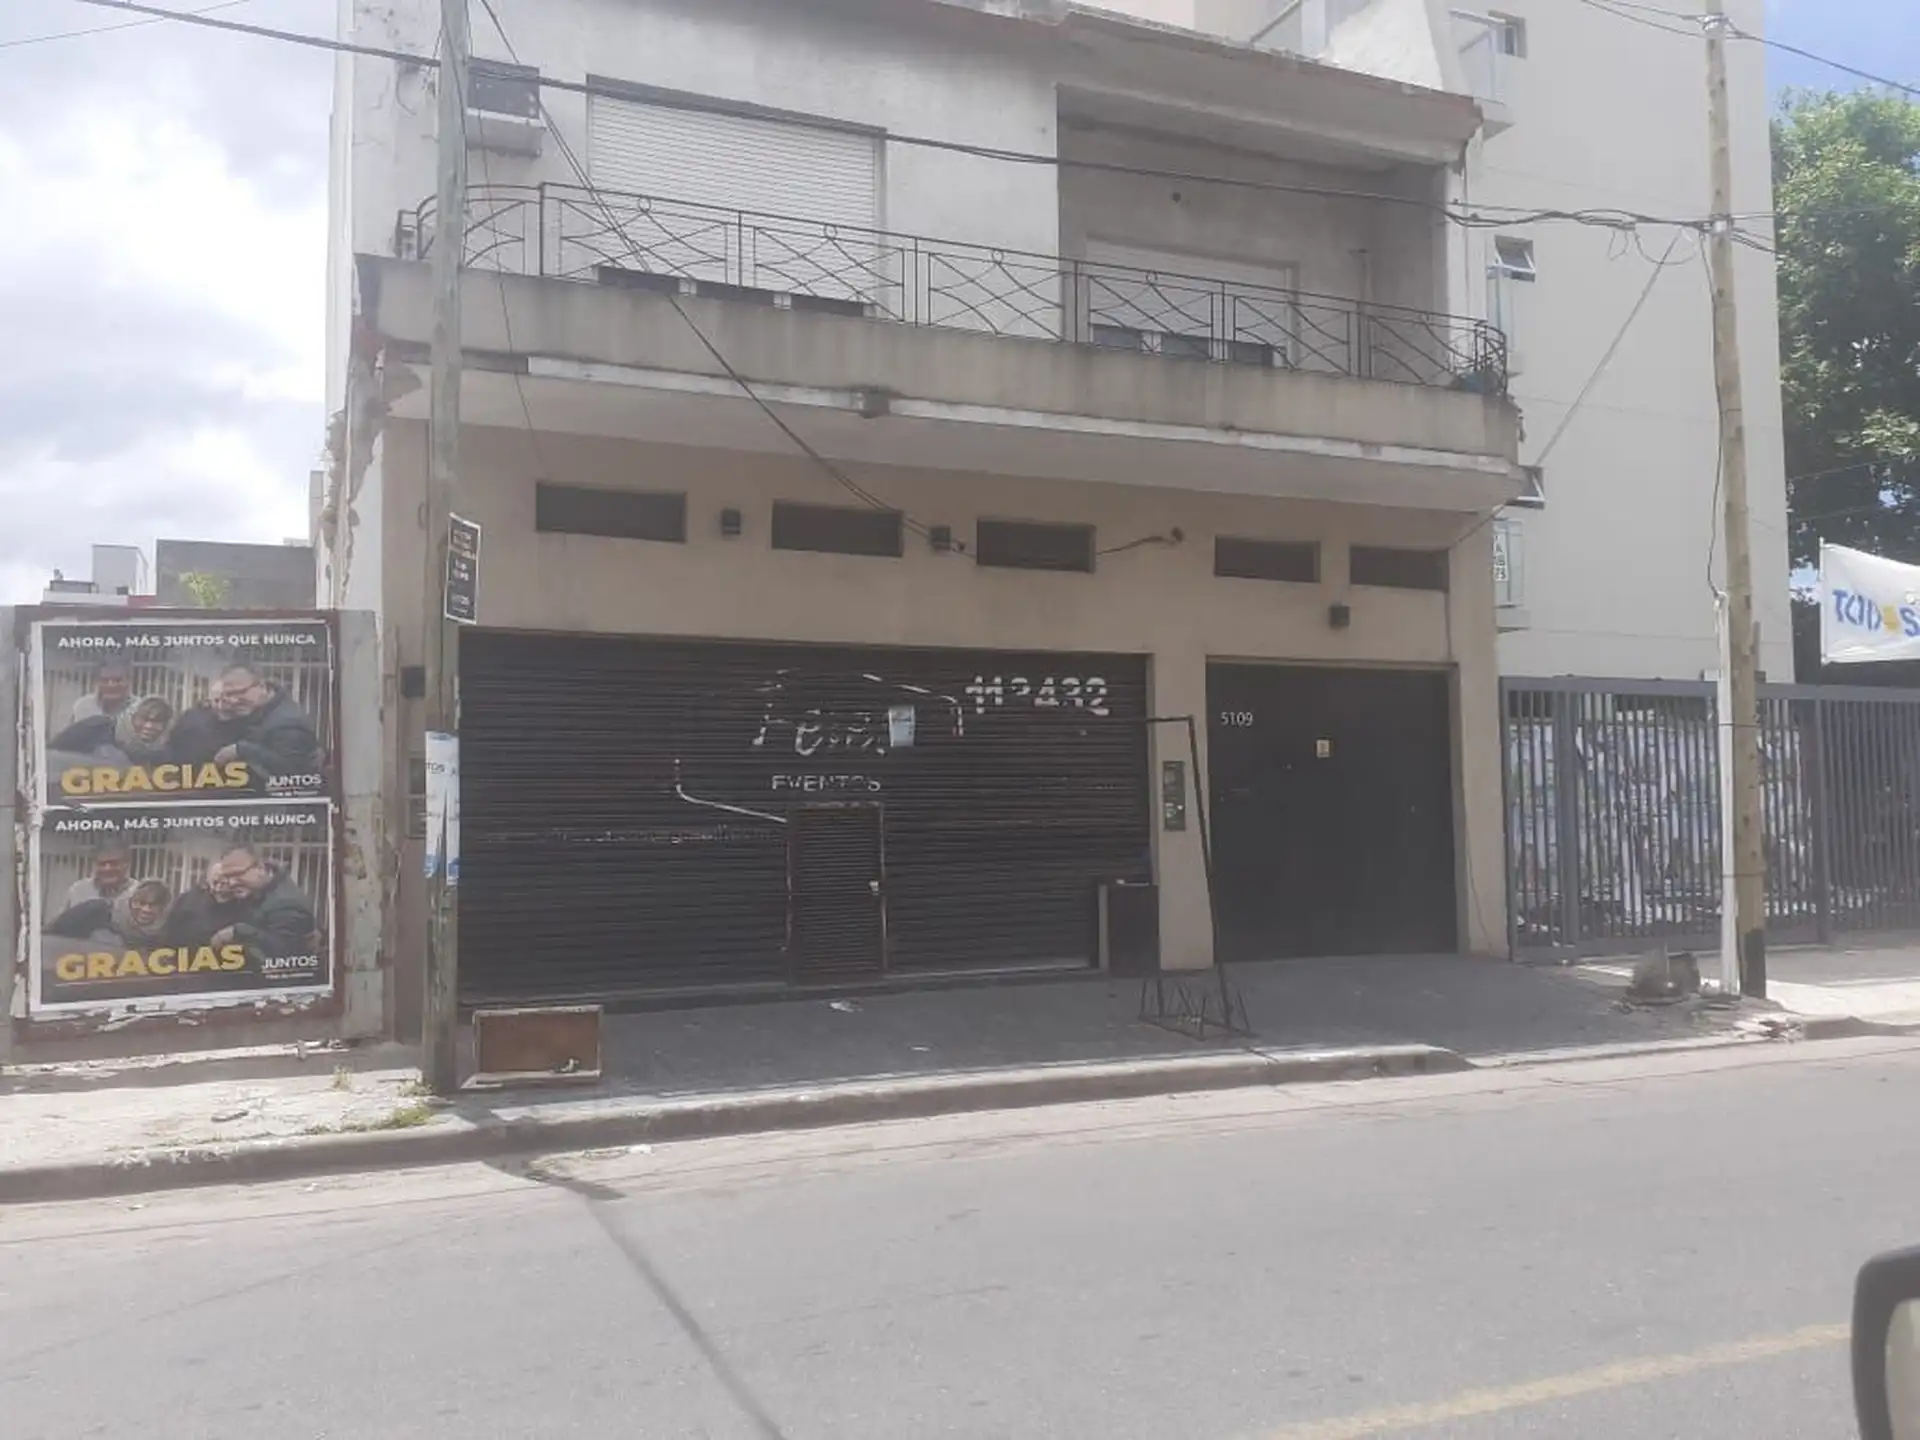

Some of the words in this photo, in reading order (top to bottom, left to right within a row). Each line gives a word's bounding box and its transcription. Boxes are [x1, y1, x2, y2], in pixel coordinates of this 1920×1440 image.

[58, 636, 121, 649] AHORA,
[126, 634, 161, 647] MÁS
[164, 635, 224, 646] JUNTOS
[229, 635, 259, 647] QUE
[264, 634, 316, 645] NUNCA
[1221, 711, 1253, 726] 5109
[61, 762, 249, 794] GRACIAS
[265, 774, 321, 787] JUNTOS
[55, 819, 120, 832] AHORA,
[124, 815, 158, 829] MÁS
[164, 817, 224, 828] JUNTOS
[229, 816, 260, 828] QUE
[264, 815, 316, 826] NUNCA
[56, 945, 245, 981] GRACIAS
[261, 956, 318, 969] JUNTOS
